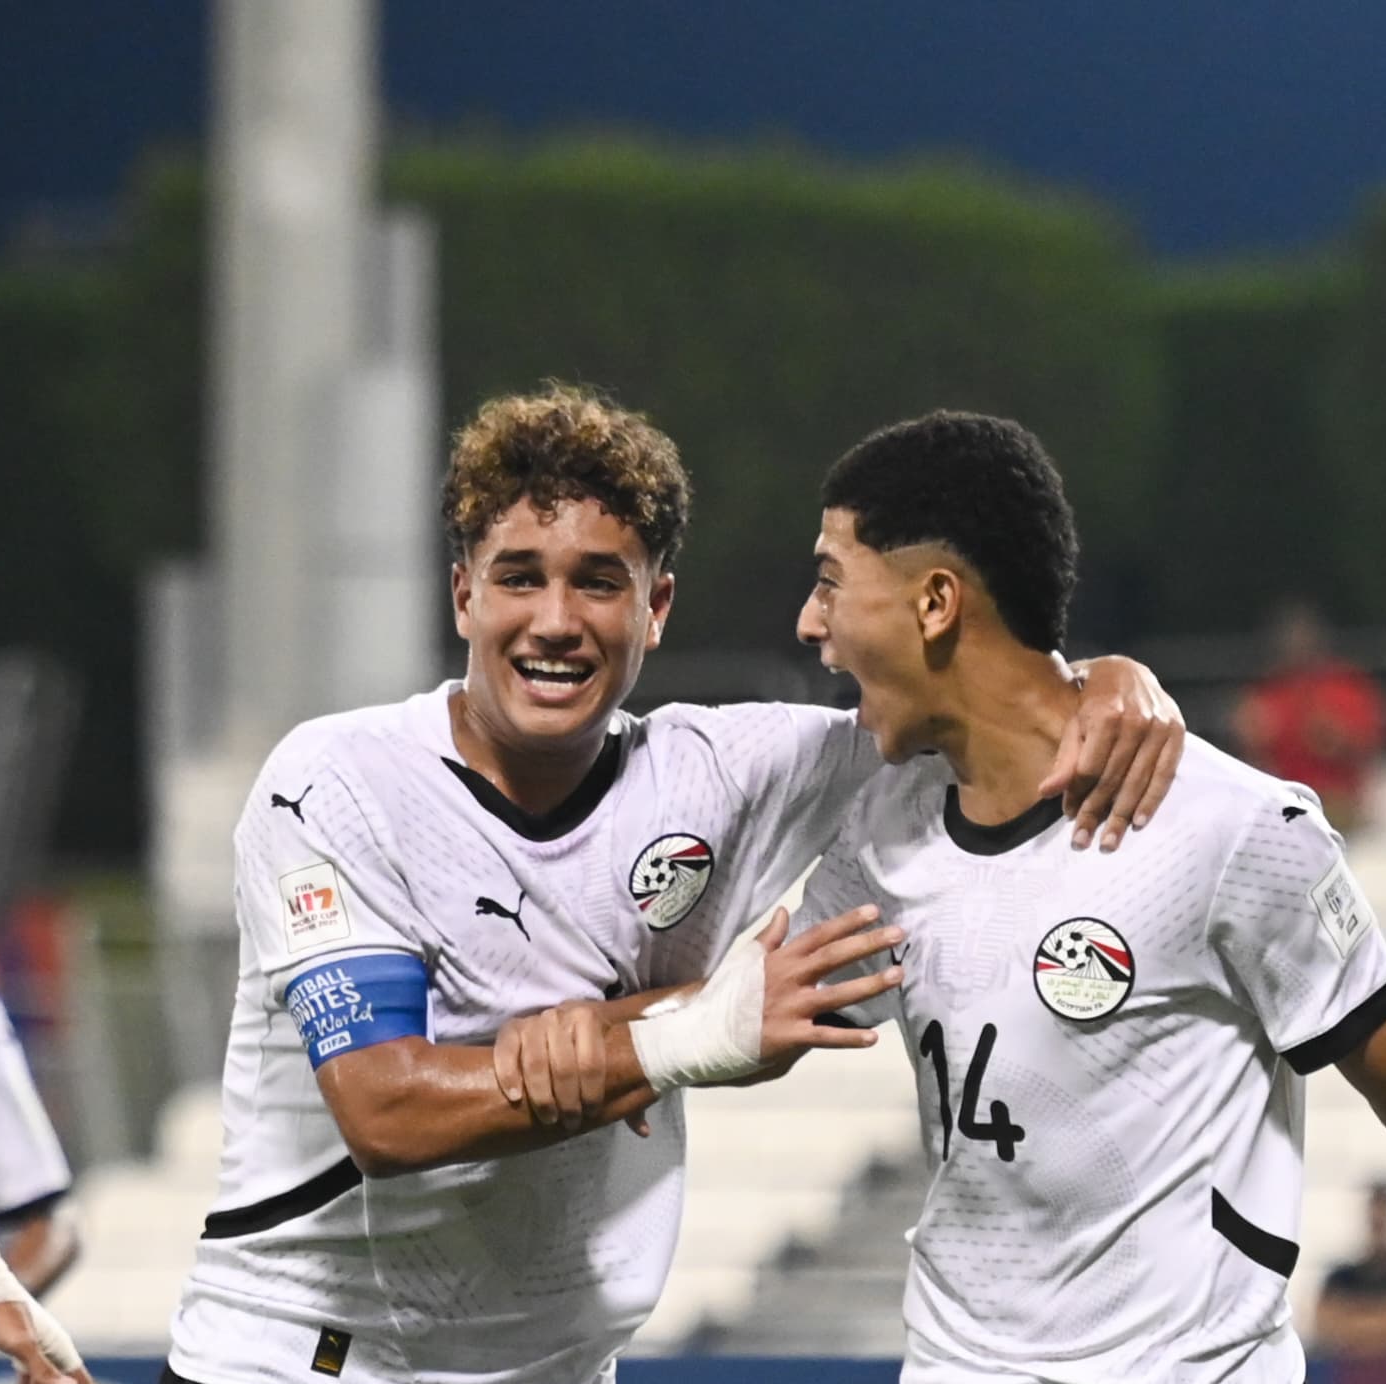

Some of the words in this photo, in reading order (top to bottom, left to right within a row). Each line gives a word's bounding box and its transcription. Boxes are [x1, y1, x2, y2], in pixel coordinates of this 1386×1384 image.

[314, 1002, 374, 1037] World
[320, 1035, 348, 1053] FIFA
[919, 1019, 1026, 1163] 14
